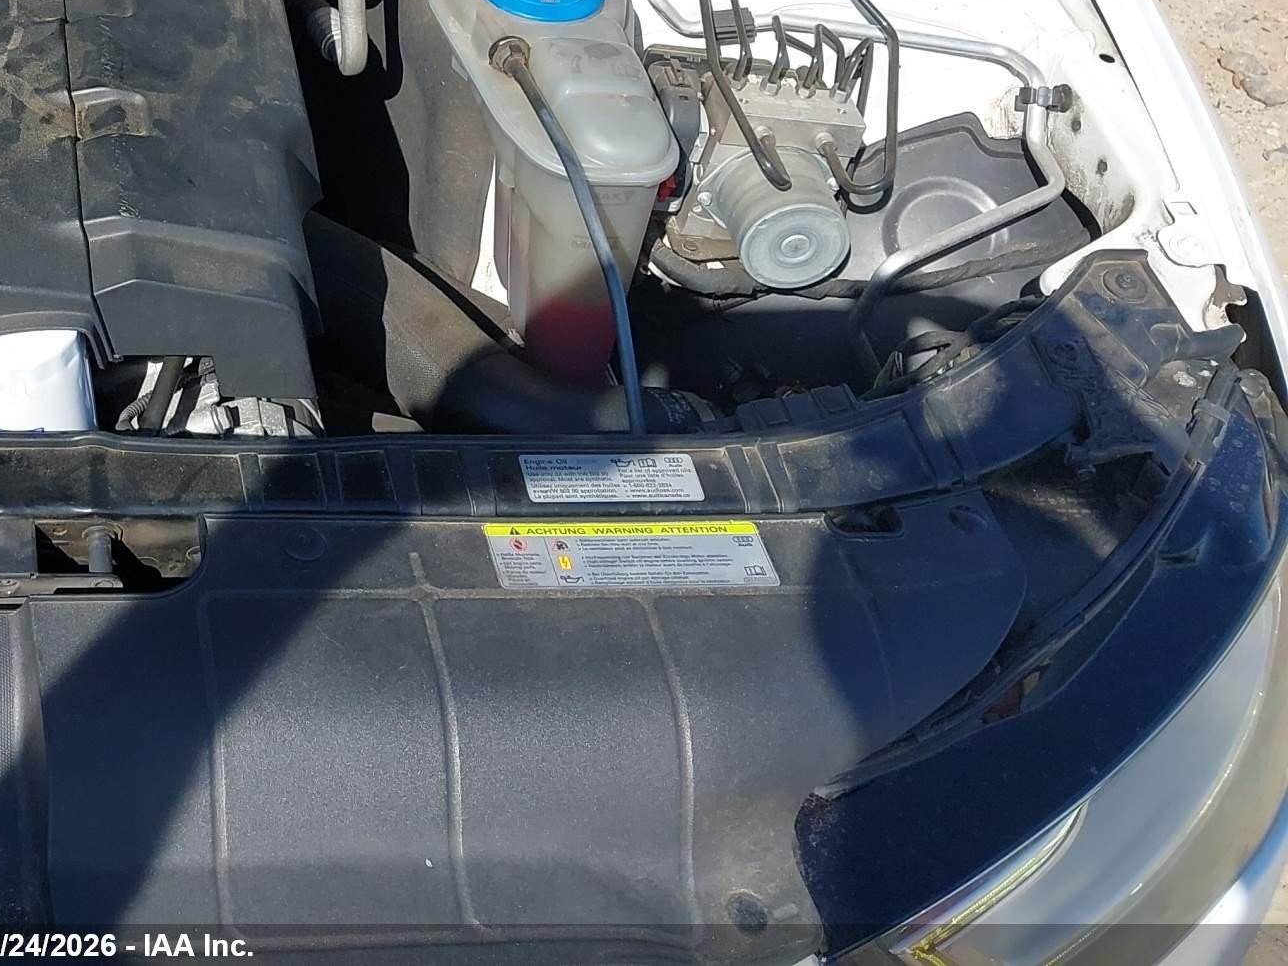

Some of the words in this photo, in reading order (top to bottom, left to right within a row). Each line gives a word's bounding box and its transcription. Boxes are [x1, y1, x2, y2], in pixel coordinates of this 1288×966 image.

[526, 527, 586, 535] ACHTUNG
[592, 526, 653, 535] WARNING
[660, 525, 728, 534] ATTENTION
